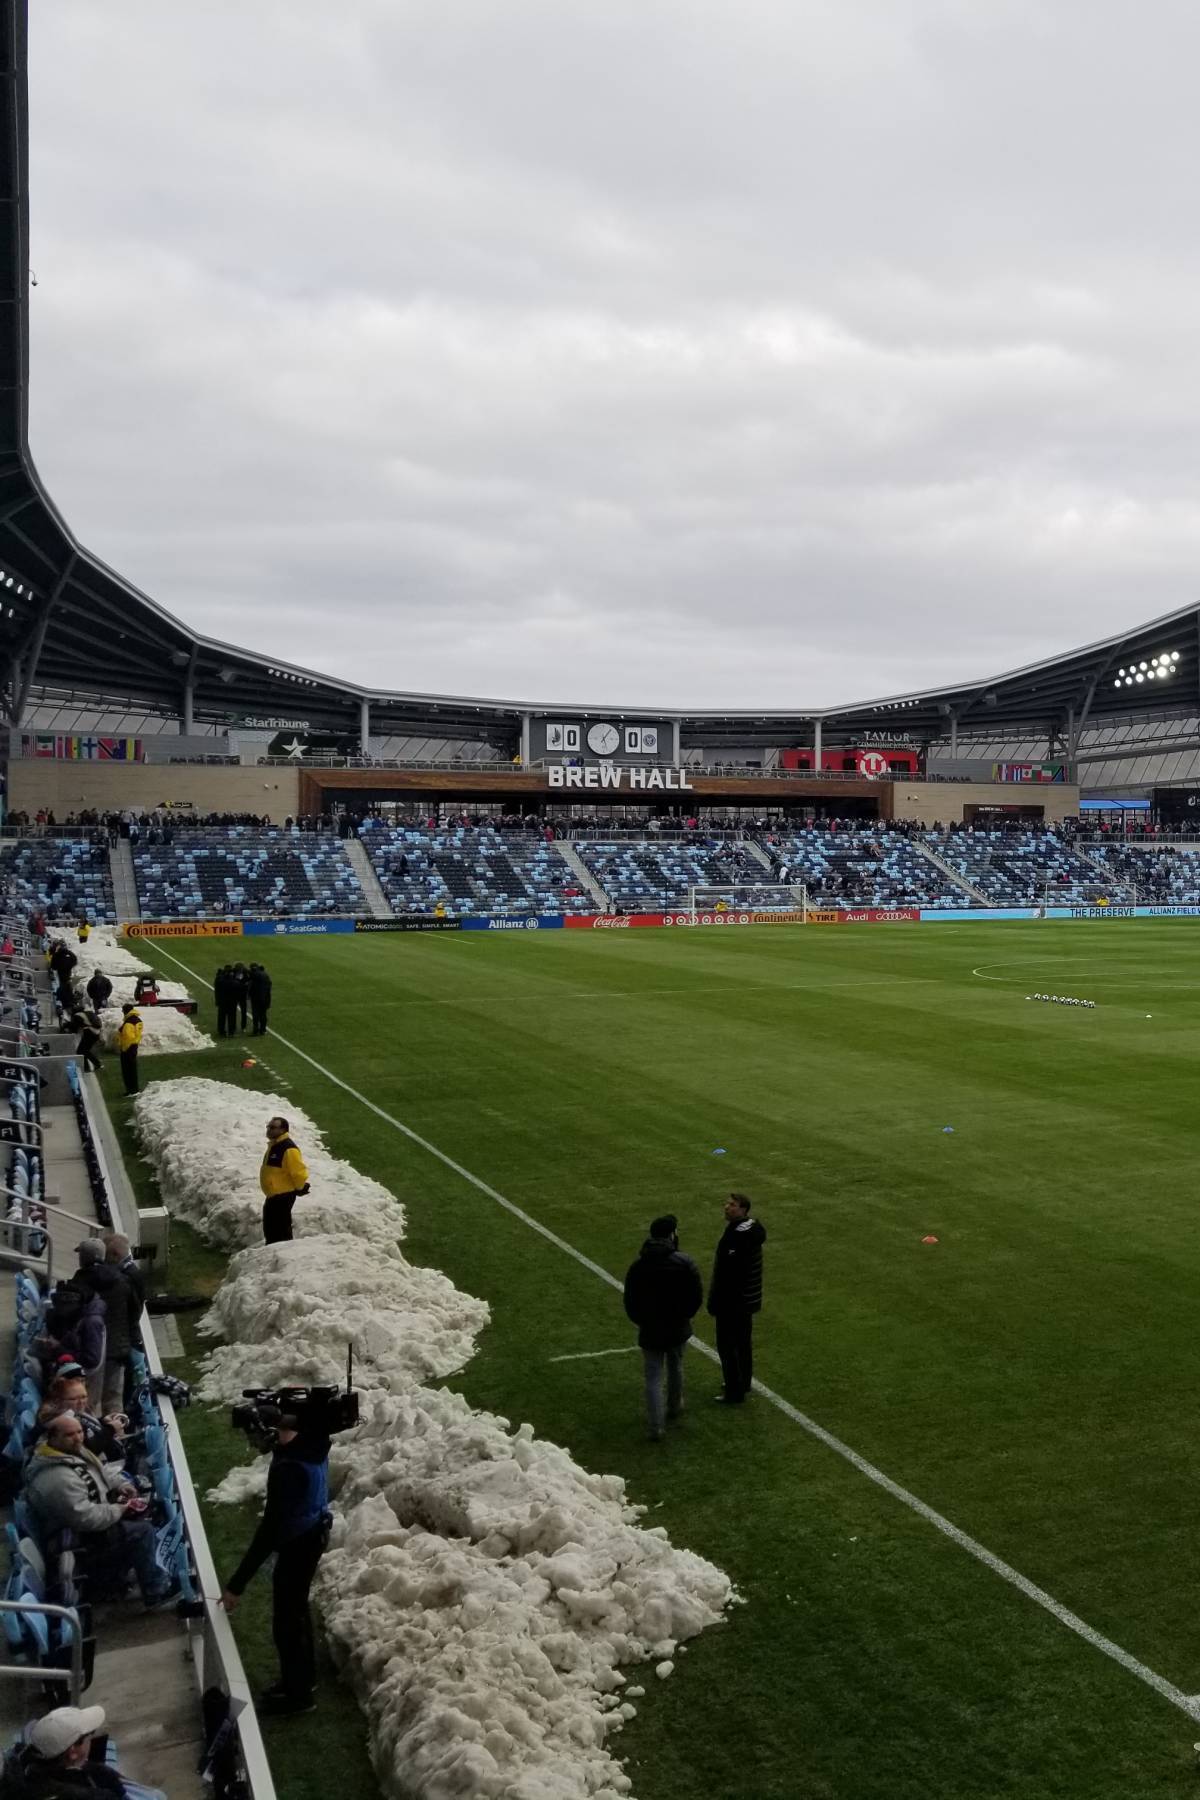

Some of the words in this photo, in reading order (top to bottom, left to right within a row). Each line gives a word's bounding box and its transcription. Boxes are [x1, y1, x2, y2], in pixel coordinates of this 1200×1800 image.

[245, 717, 310, 729] StarTribune
[567, 729, 577, 746] 0
[628, 732, 638, 748] 0
[864, 731, 910, 742] TAYLOR
[549, 766, 622, 788] BREW
[630, 768, 693, 790] HALL
[754, 913, 804, 923] Continental
[815, 914, 836, 922] TIRE
[846, 913, 869, 921] Audi
[1070, 908, 1087, 918] THE
[1089, 907, 1135, 918] PRESERVE
[1149, 907, 1176, 915] ALLIANZ
[1177, 907, 1196, 915] FIELD
[288, 924, 327, 933] SeatGeek
[488, 919, 524, 929] Allianz
[127, 924, 198, 937] Continental
[211, 926, 239, 935] TIRE
